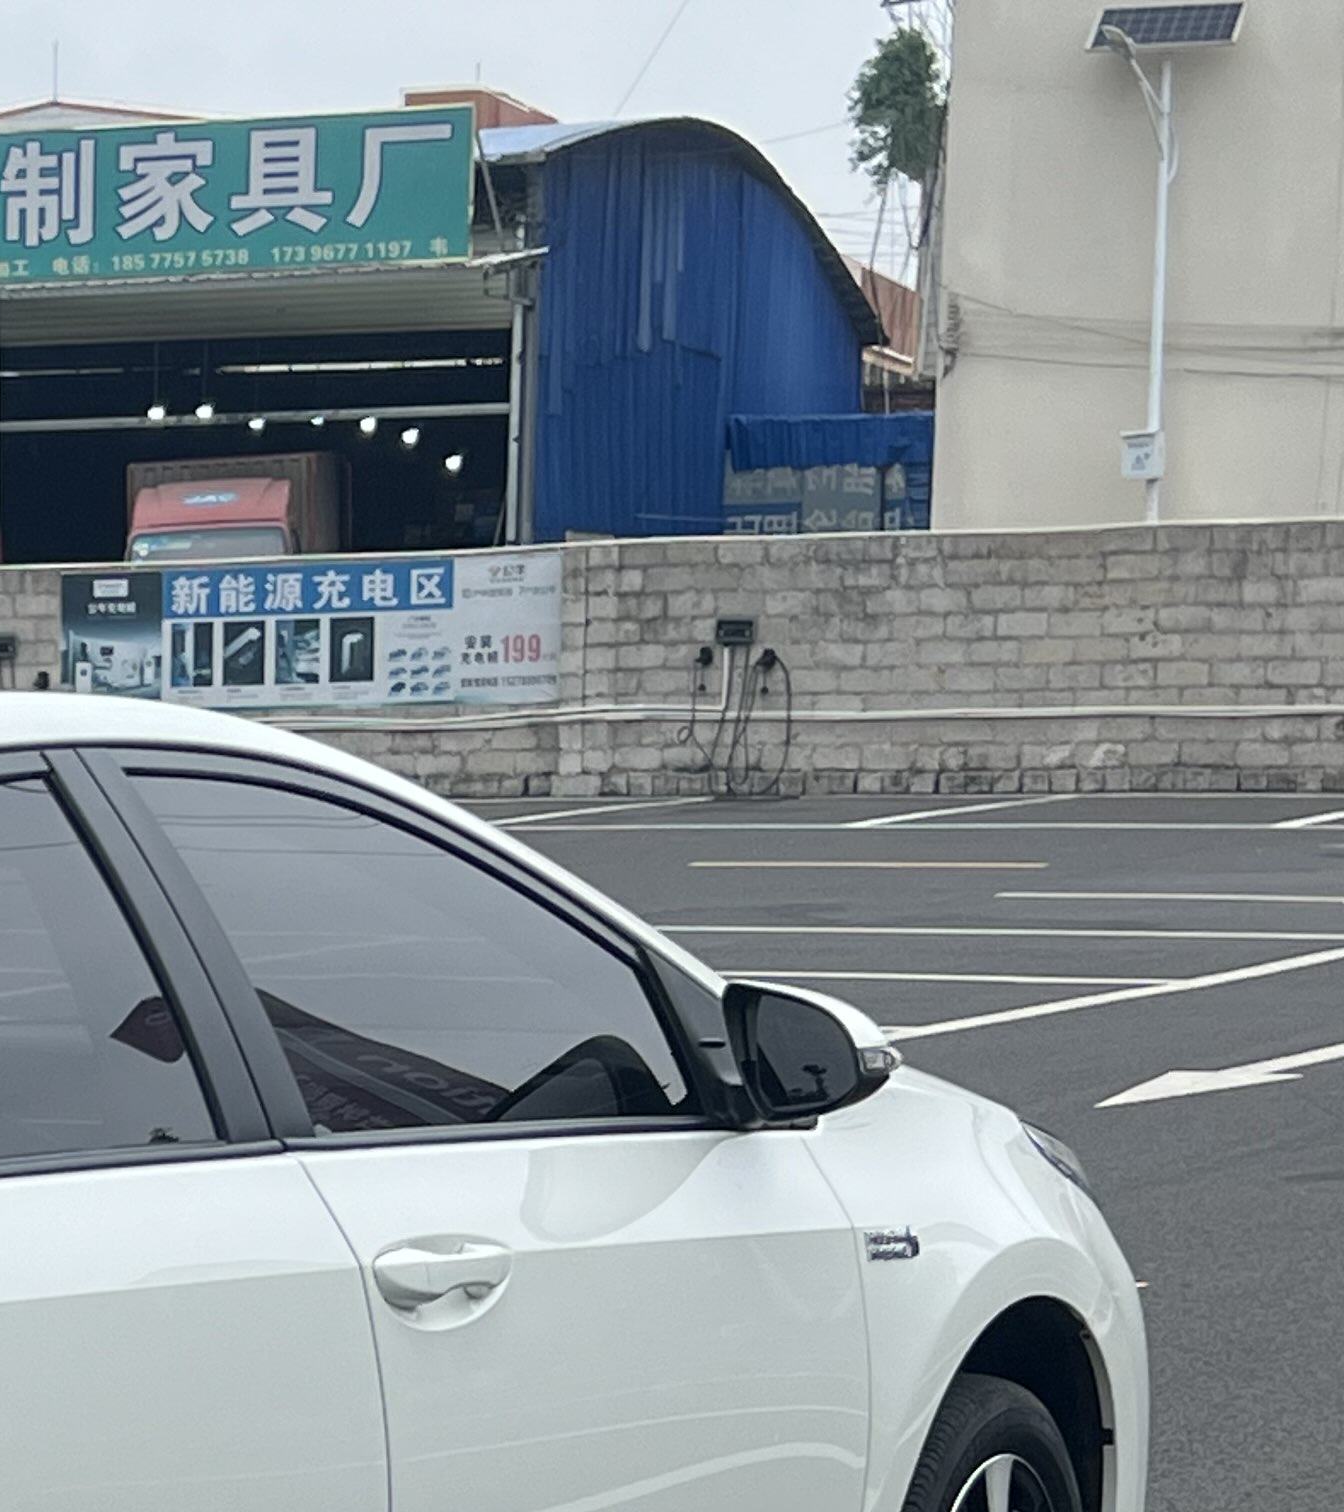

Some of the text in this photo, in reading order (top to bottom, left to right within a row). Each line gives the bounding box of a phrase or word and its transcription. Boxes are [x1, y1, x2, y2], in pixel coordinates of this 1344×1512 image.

[270, 246, 307, 263] 173
[364, 240, 413, 259] 1197
[170, 566, 447, 616] 新能源充电区
[500, 632, 542, 664] 199
